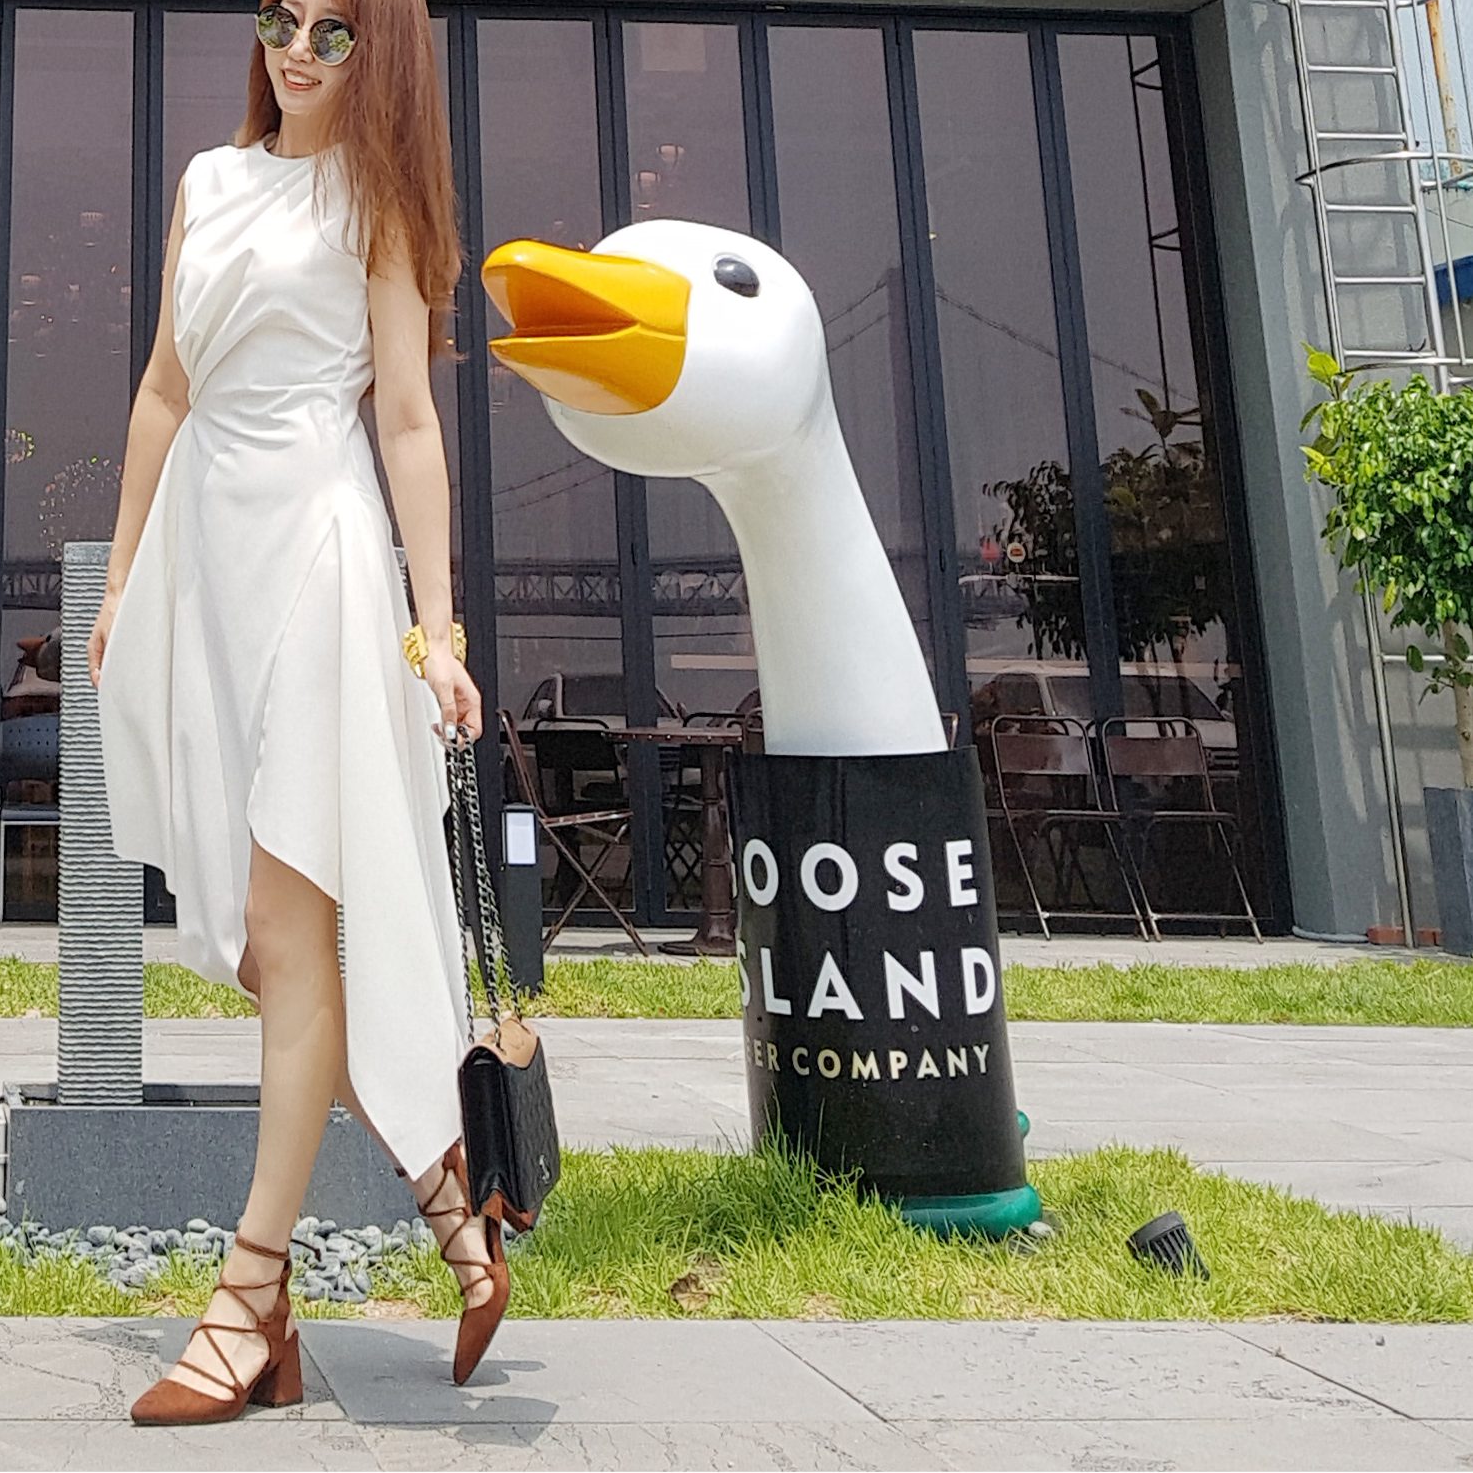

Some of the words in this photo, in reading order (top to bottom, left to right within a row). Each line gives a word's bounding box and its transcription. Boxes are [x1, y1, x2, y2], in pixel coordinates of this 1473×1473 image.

[729, 833, 978, 913] OOSE
[736, 939, 997, 1021] SLAND
[791, 1043, 991, 1081] COMPANY
